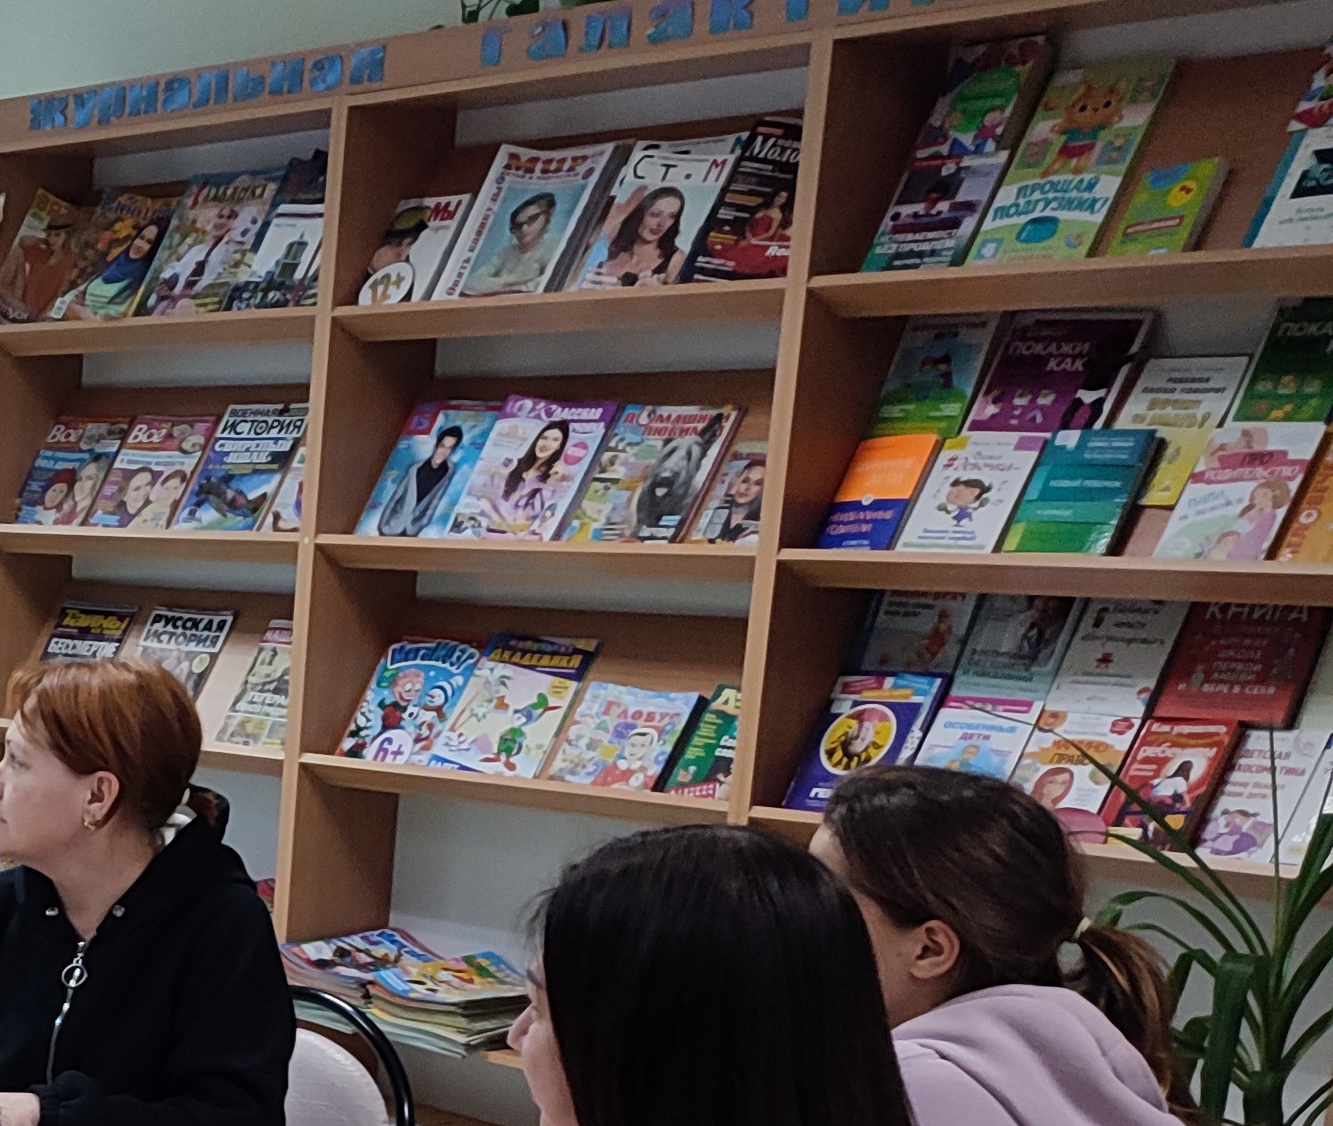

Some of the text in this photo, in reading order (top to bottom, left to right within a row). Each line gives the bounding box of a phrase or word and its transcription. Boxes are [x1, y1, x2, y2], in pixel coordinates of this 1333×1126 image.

[369, 272, 406, 298] 12+
[220, 418, 304, 435] ИСТОРИЯ
[151, 614, 229, 631] РУССКАЯ
[143, 629, 221, 648] ИСТОРИЯ
[943, 721, 1019, 734] ОСОБЕННЫЕ
[959, 731, 992, 742] ДЕТИ
[372, 736, 405, 762] 6+
